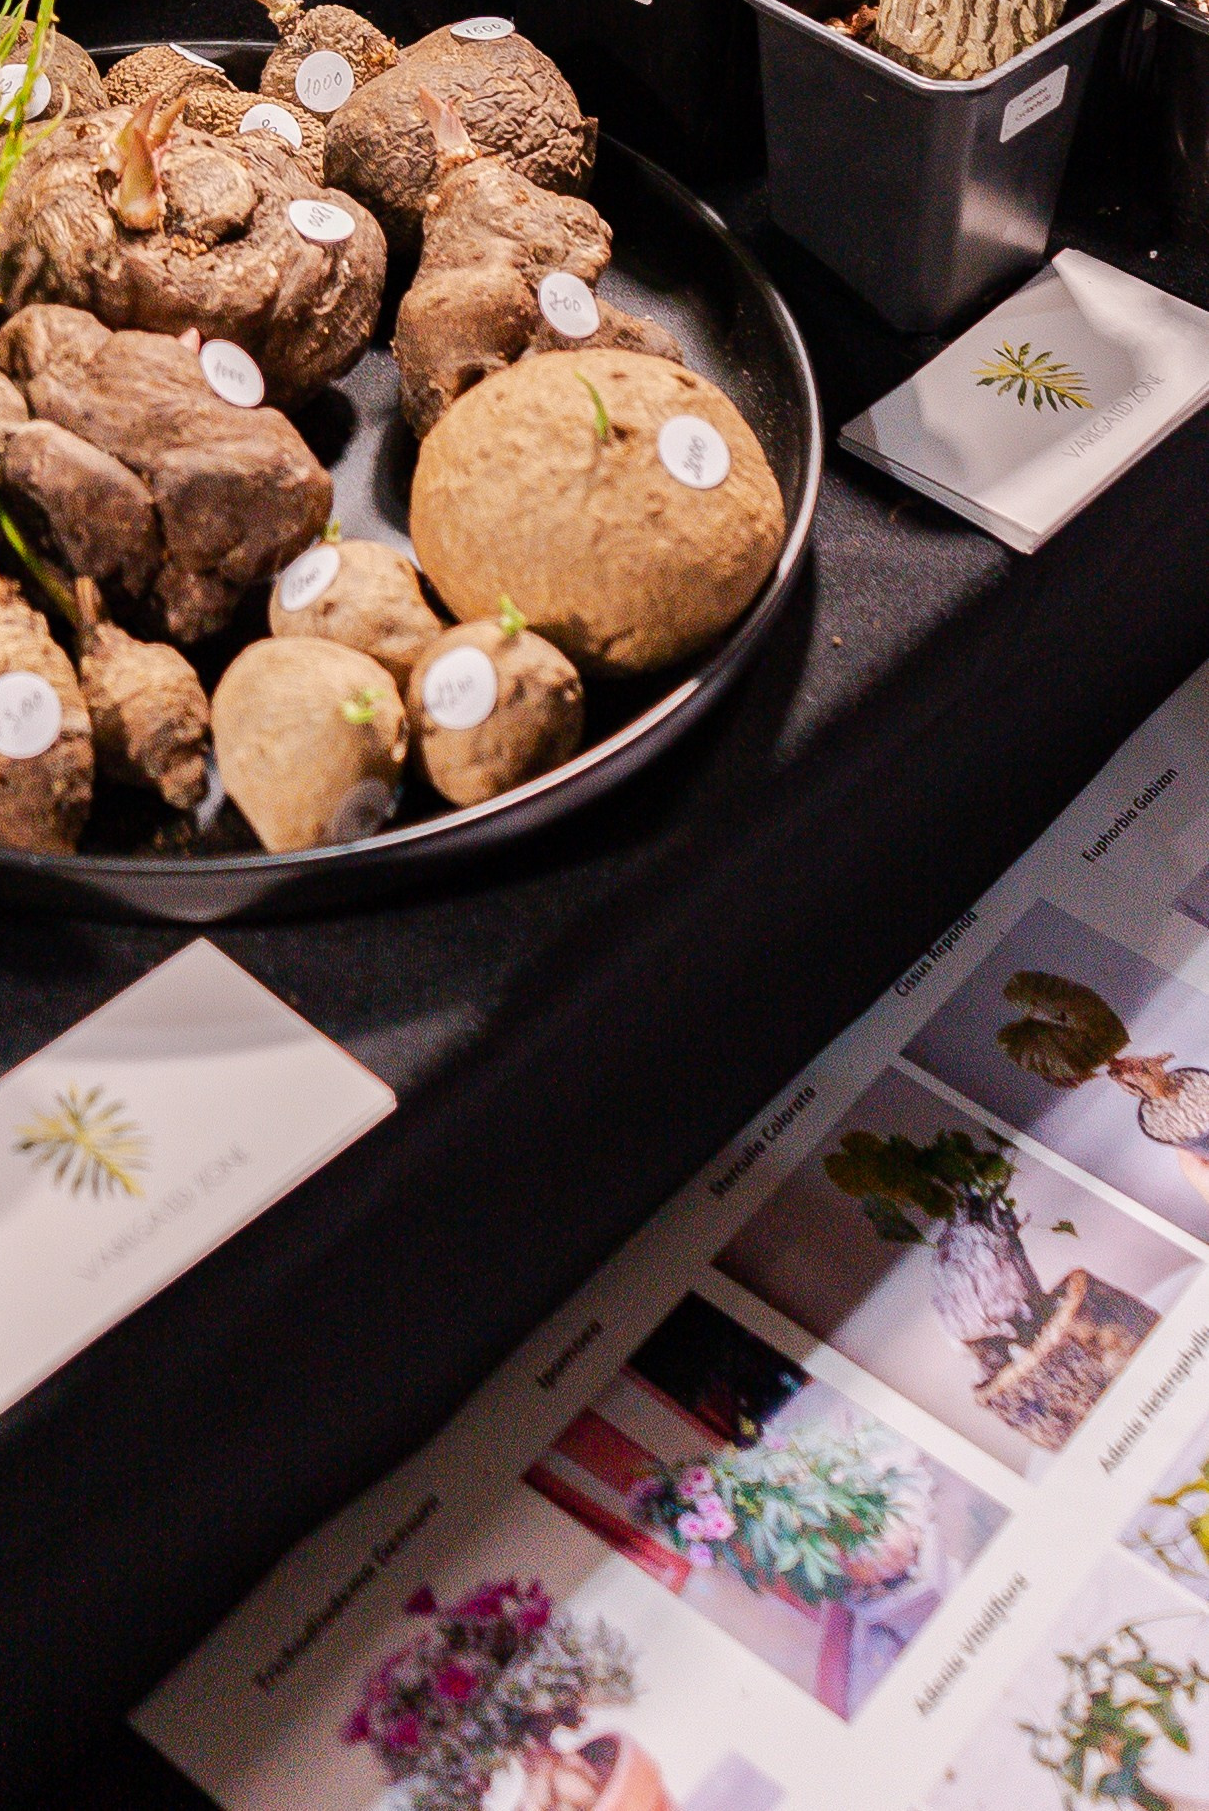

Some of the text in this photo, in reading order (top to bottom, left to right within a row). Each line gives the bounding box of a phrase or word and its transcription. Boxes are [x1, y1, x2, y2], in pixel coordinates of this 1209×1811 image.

[304, 71, 343, 101] 1000
[1060, 372, 1167, 458] VARIEGATED ZONE
[1081, 768, 1179, 864] Euphorbia Gabizan
[894, 909, 978, 998] Cissus Repanda
[709, 1085, 817, 1197] Sterculia Colorata
[1097, 1414, 1147, 1477] Adenia
[913, 1651, 967, 1718] Adenia
